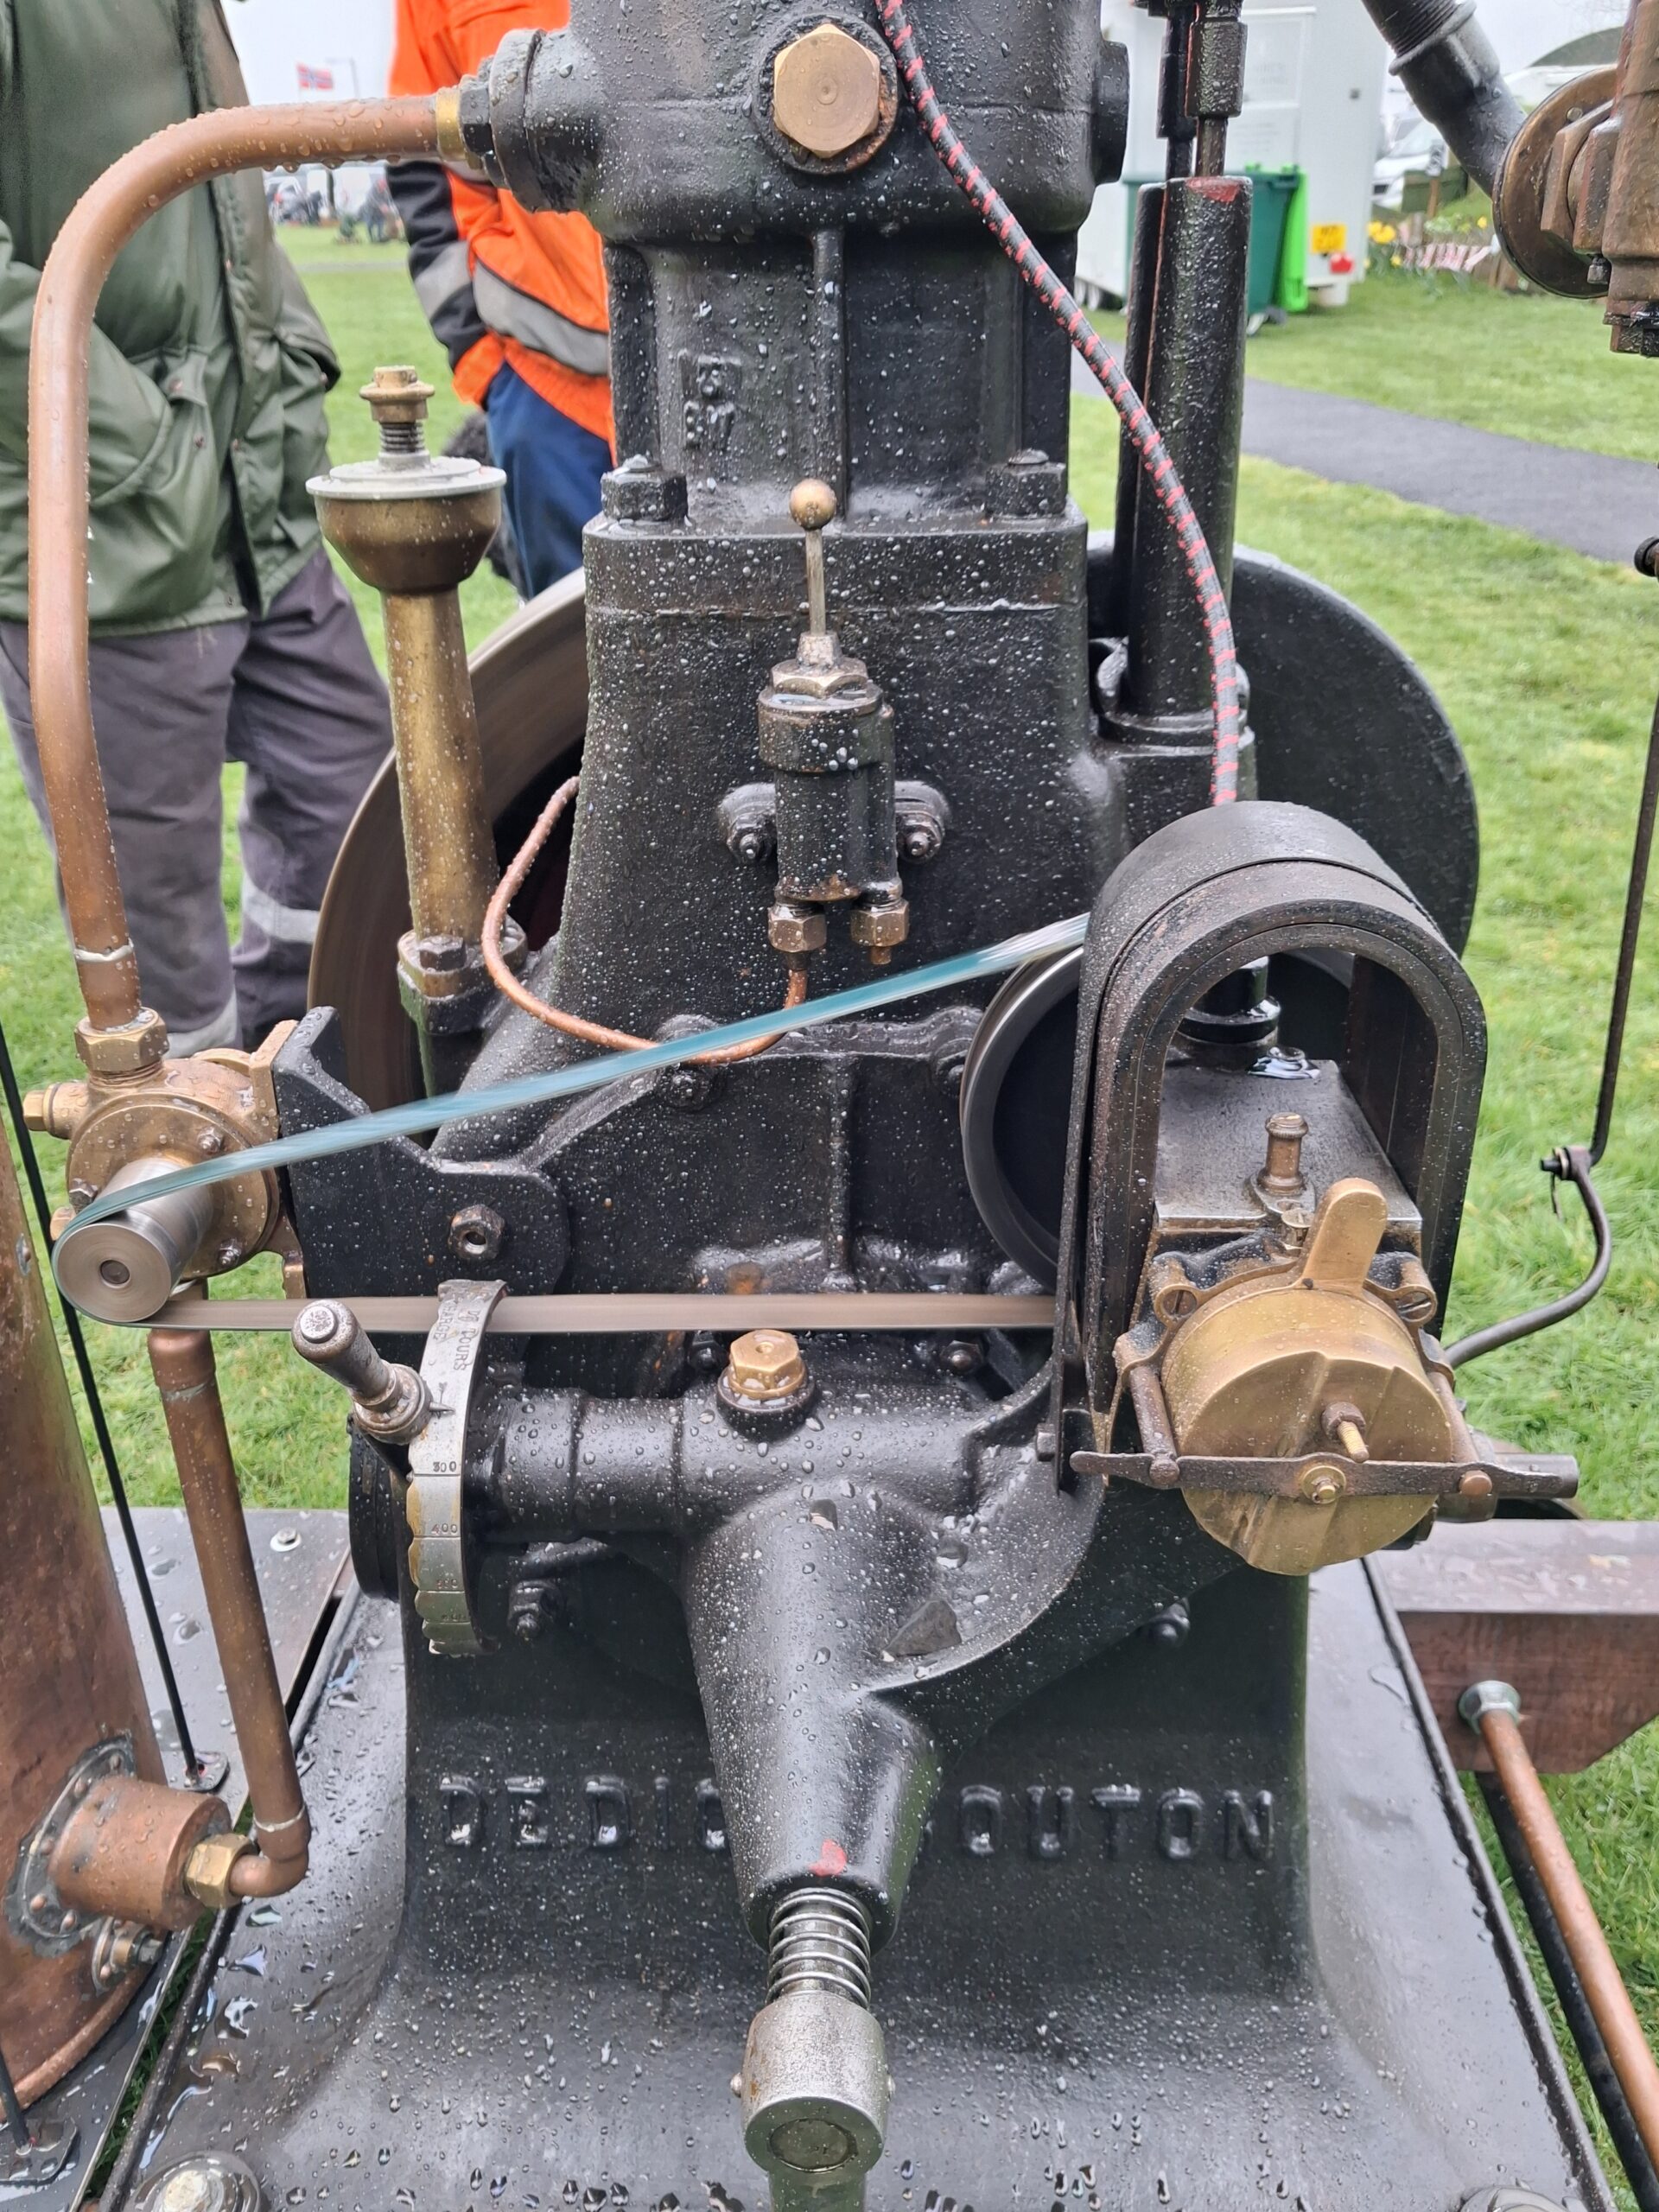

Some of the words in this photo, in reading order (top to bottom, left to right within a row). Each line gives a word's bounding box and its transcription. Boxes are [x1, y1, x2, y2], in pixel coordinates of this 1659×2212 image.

[433, 1461, 457, 1473] 300
[432, 1523, 458, 1535] 400
[440, 1776, 548, 1847] DE
[584, 1776, 726, 1850] DIO
[925, 1784, 1274, 1860] OUTON
